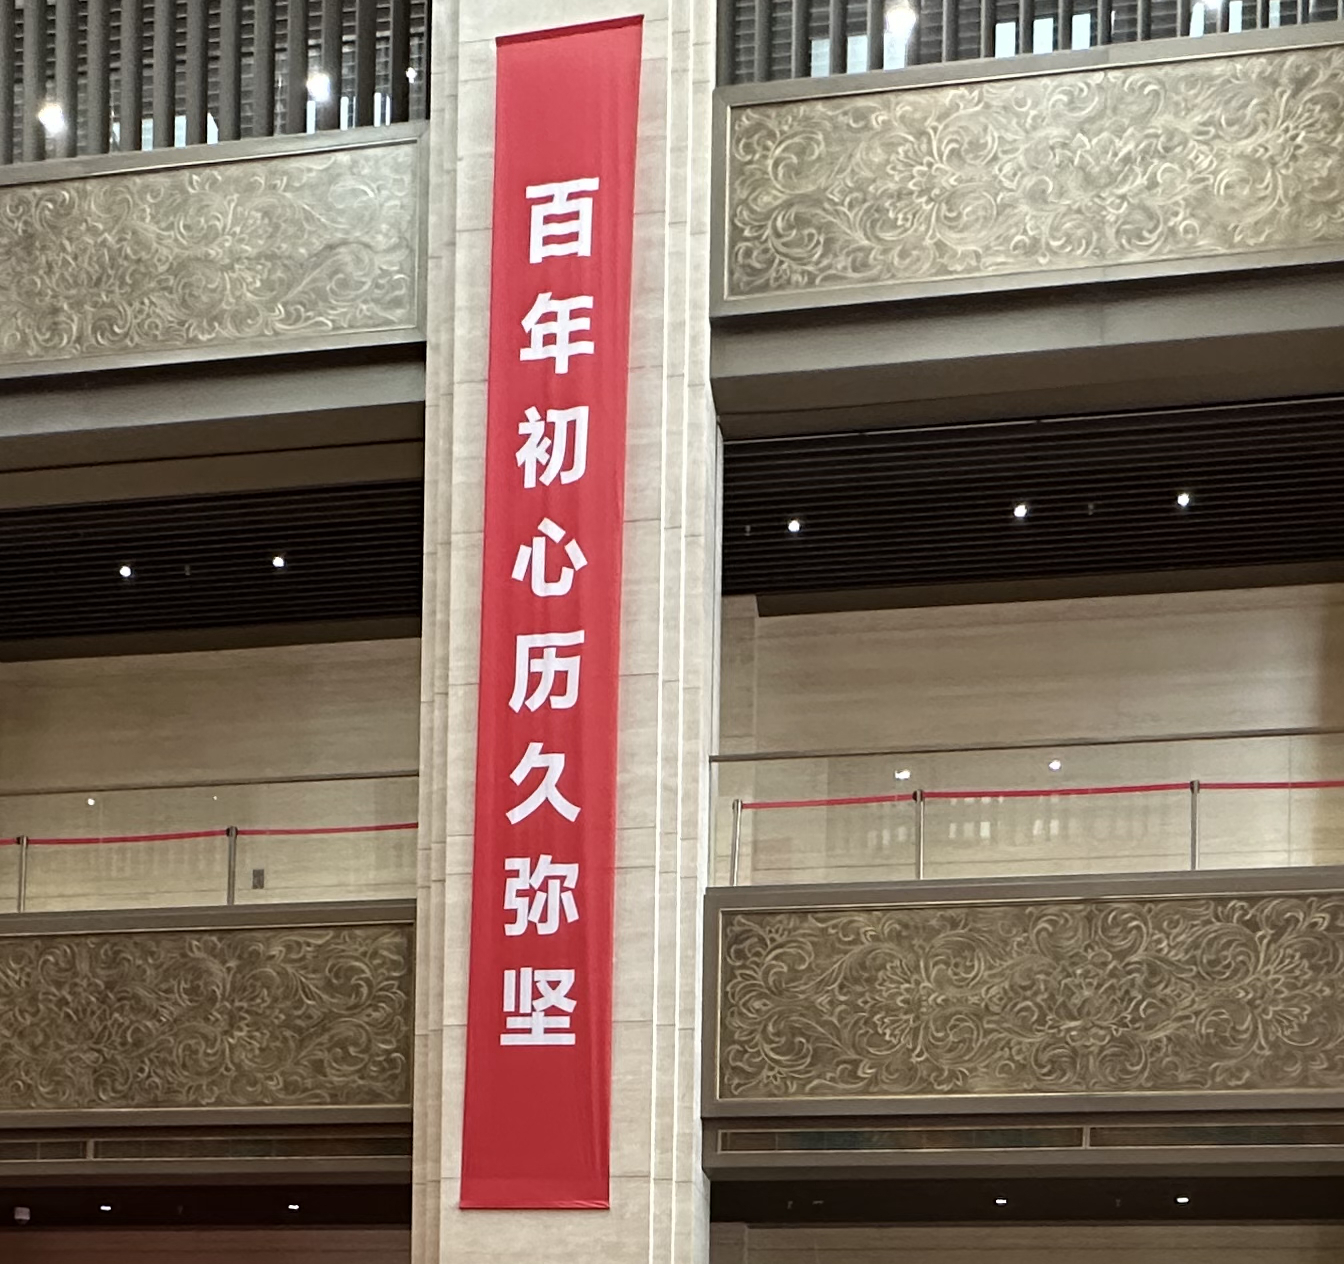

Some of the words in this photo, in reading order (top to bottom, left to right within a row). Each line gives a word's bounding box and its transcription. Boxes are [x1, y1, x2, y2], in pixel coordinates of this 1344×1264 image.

[500, 177, 599, 1048] 百年初心历久弥坚
